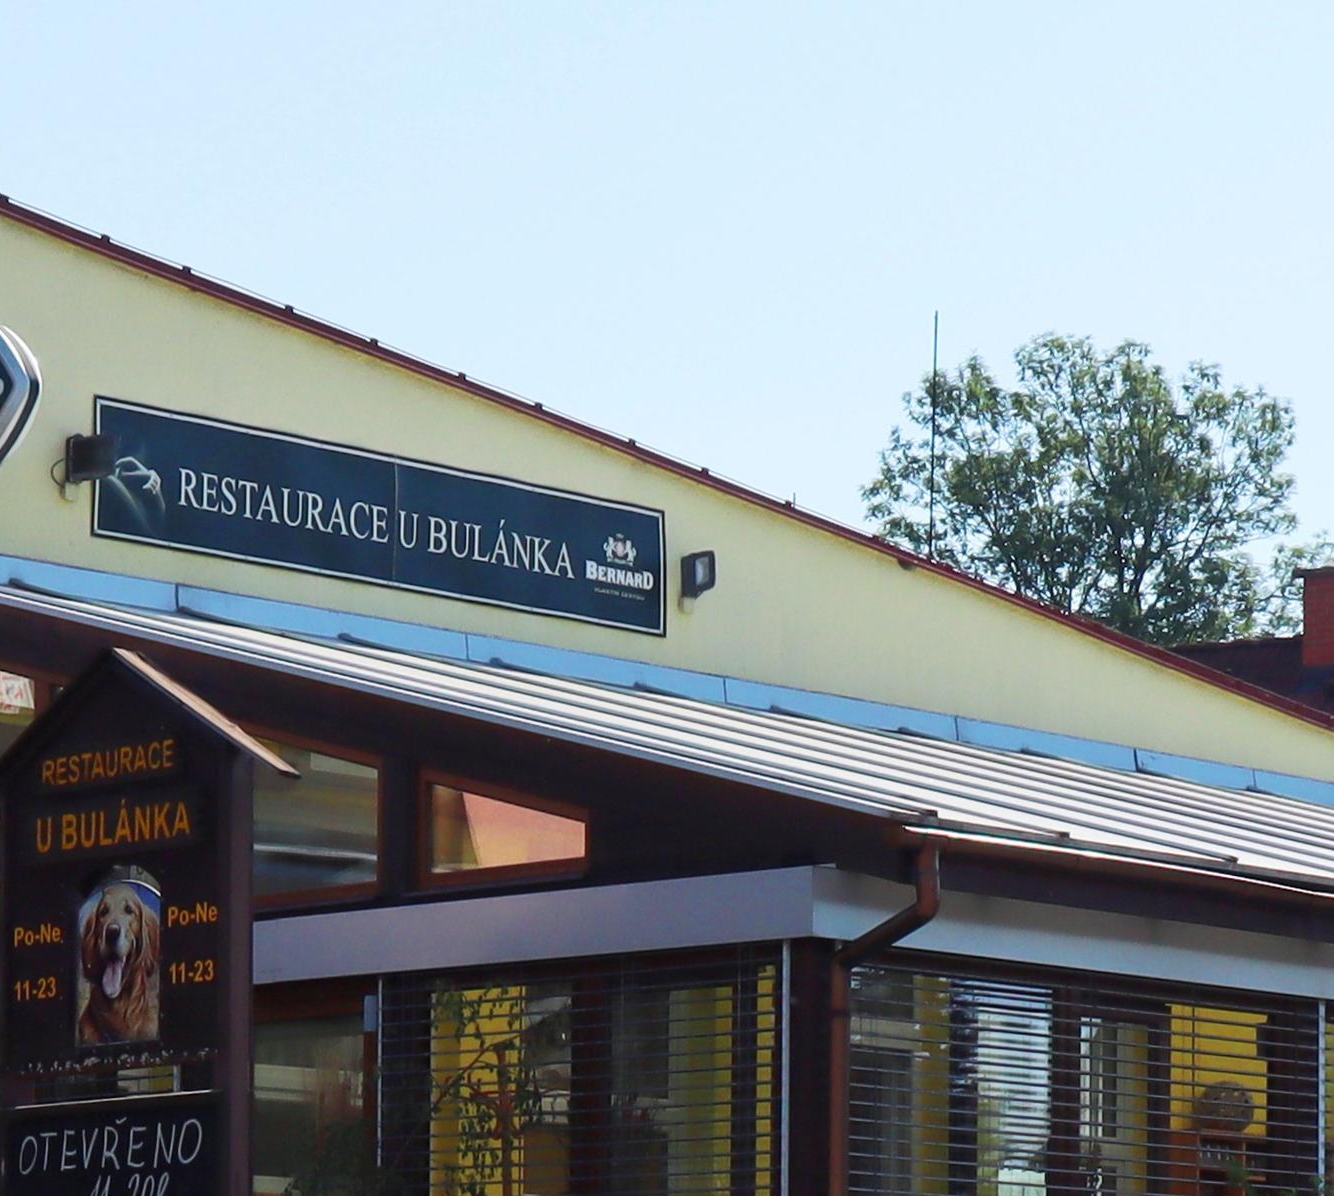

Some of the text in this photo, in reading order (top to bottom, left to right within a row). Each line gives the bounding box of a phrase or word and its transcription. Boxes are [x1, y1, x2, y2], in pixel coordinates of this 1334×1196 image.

[177, 467, 576, 580] RESTAURACE U BULÁNKA
[585, 559, 654, 590] BERNARD
[41, 738, 175, 787] RESTAURACE
[36, 799, 190, 854] U BULÁNKA
[167, 900, 219, 928] Po-Ne
[13, 924, 61, 948] Po-Ne
[169, 959, 215, 985] 11-23
[13, 976, 57, 1002] 11-23
[18, 1116, 203, 1176] OTEVŘENO
